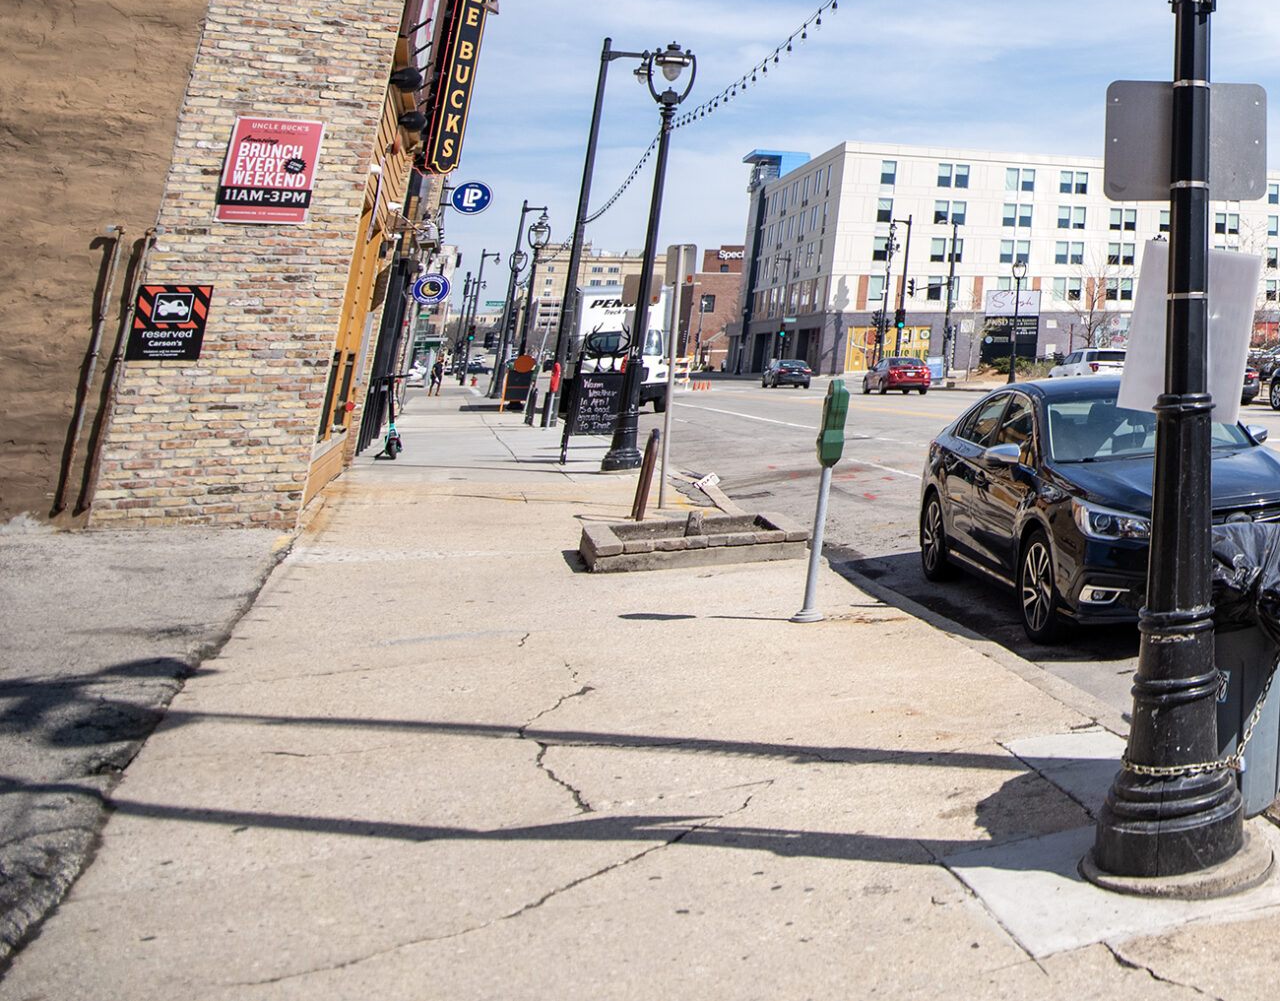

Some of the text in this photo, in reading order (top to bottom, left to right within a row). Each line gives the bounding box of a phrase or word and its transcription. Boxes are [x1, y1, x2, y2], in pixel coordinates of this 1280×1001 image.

[441, 41, 473, 158] BUCKS
[252, 122, 309, 132] UNCLE BUCK'S
[238, 142, 304, 159] BRUNCH
[235, 156, 285, 172] EVERY
[232, 170, 306, 188] WEEKEND
[225, 189, 307, 203] 11AM-3PM
[462, 188, 482, 207] LP
[141, 329, 193, 338] reserved
